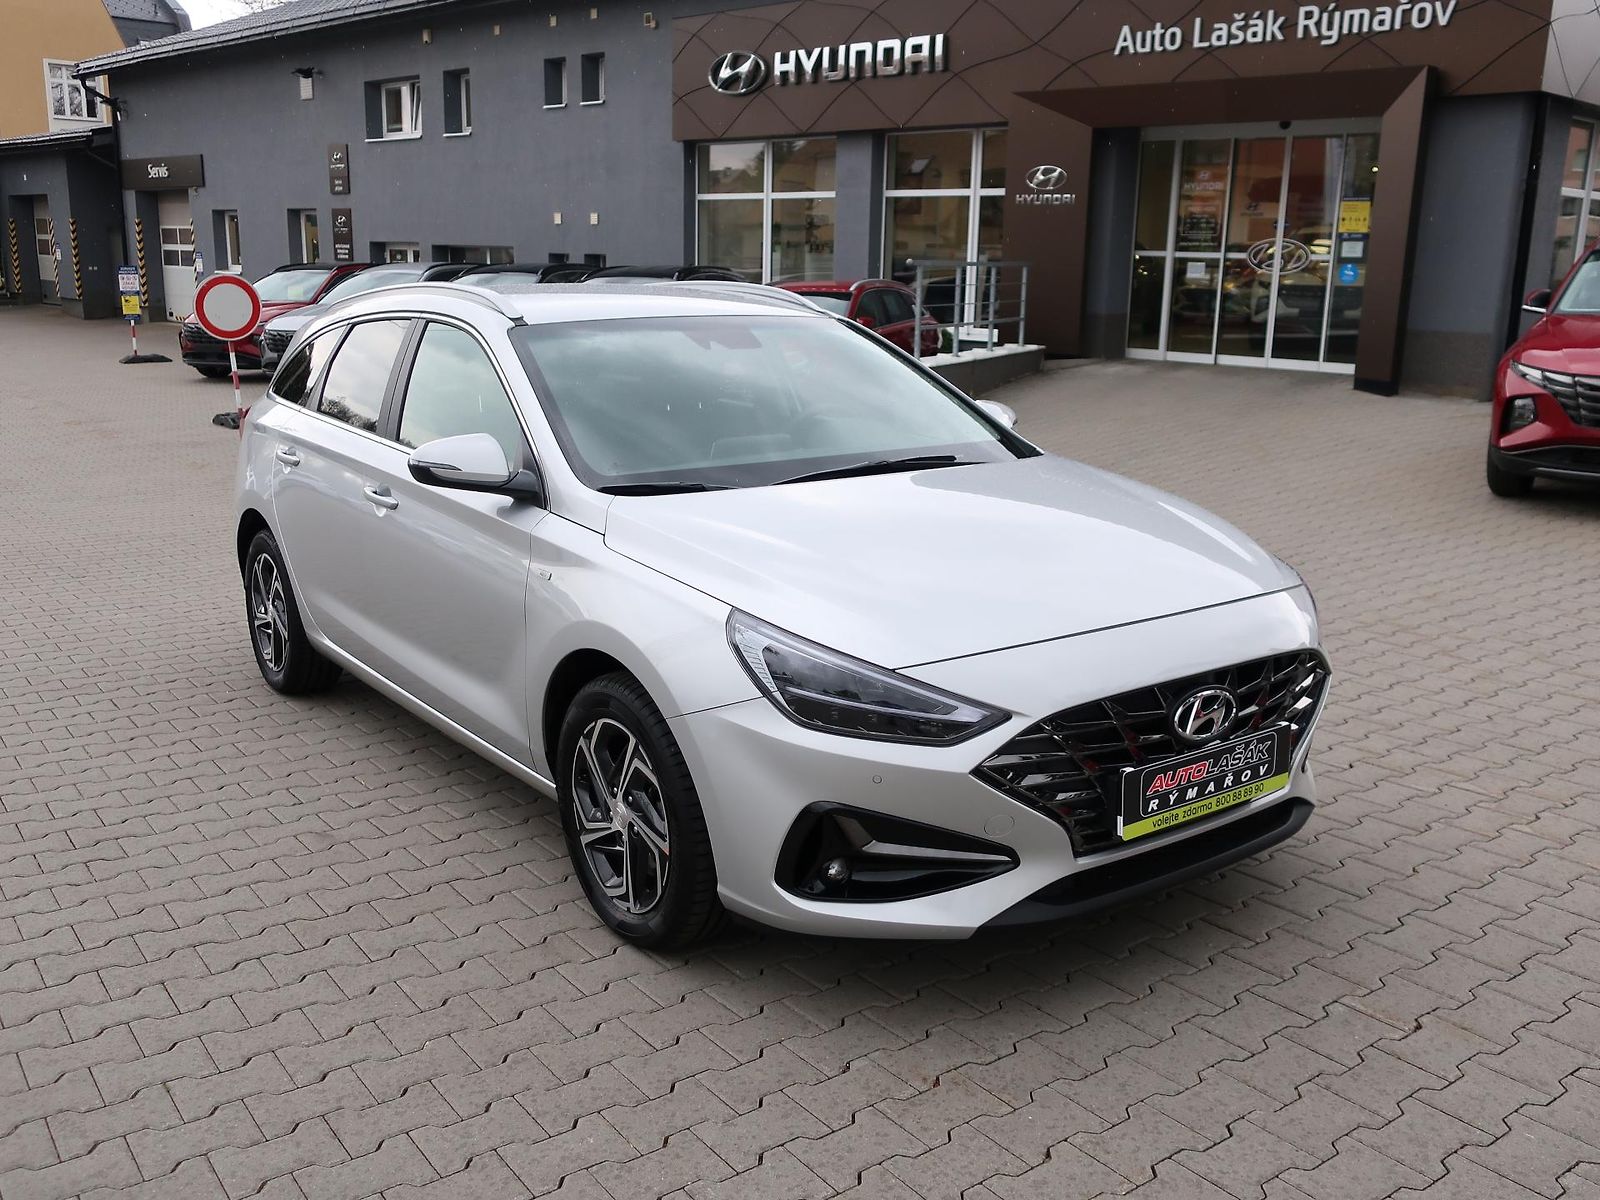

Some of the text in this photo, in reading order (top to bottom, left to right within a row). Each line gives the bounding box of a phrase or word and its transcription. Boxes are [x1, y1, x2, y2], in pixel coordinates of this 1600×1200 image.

[1114, 0, 1455, 55] Auto Lašák Rýmařov
[774, 33, 946, 86] HYUNDAI
[147, 163, 169, 178] Servis
[1015, 193, 1076, 205] HYUNDAI
[1147, 764, 1269, 812] RÝMAŘOV
[1152, 783, 1264, 828] volejte zdarma 800 88 89 90
